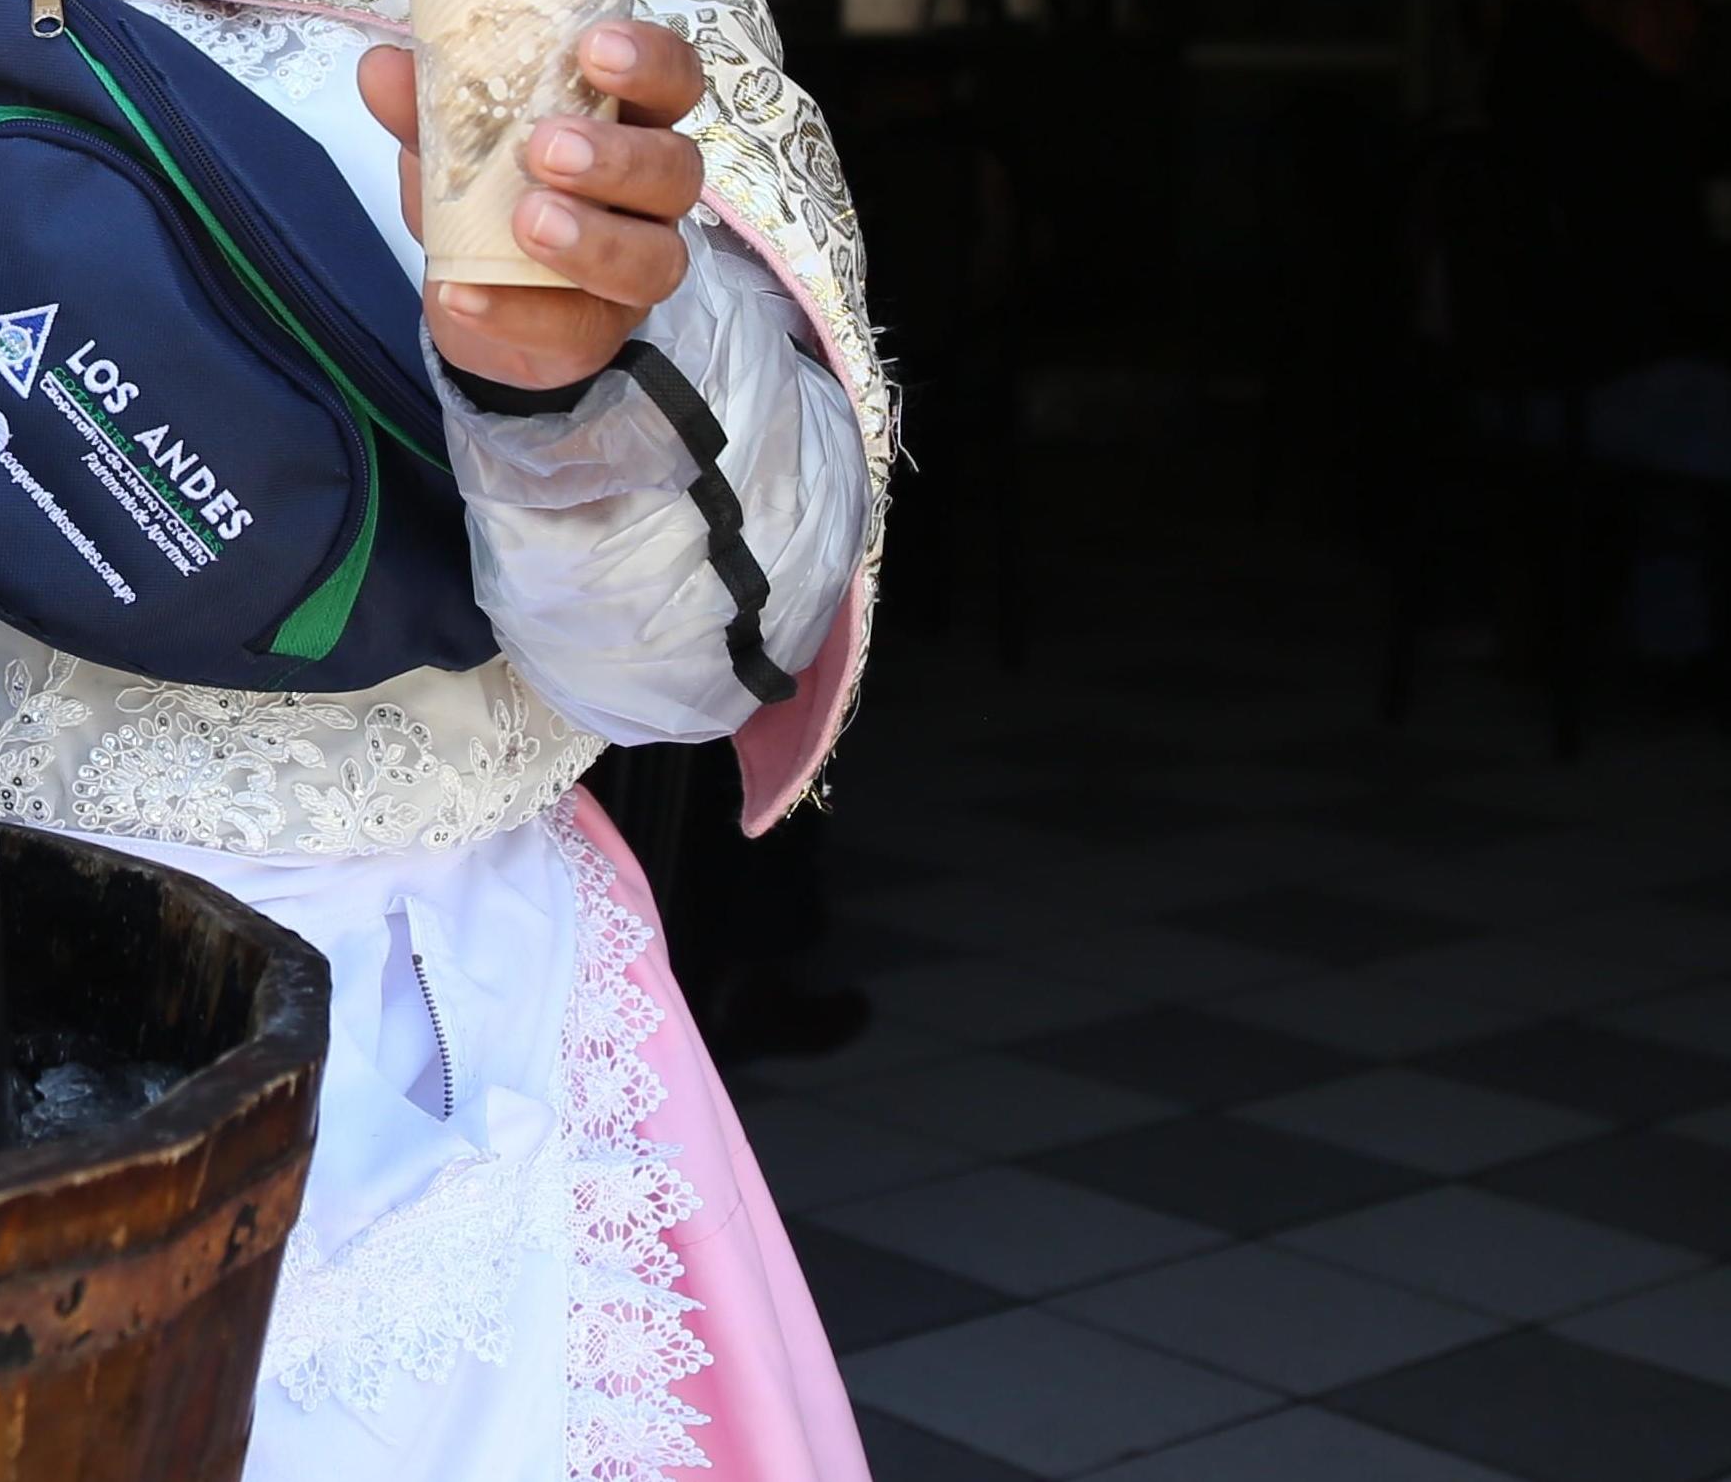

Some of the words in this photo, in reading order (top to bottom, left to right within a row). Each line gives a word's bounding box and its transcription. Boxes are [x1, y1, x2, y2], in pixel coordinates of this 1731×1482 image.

[38, 375, 111, 456] Cooperativa
[65, 339, 140, 414] LOS
[134, 424, 254, 540] ANDES
